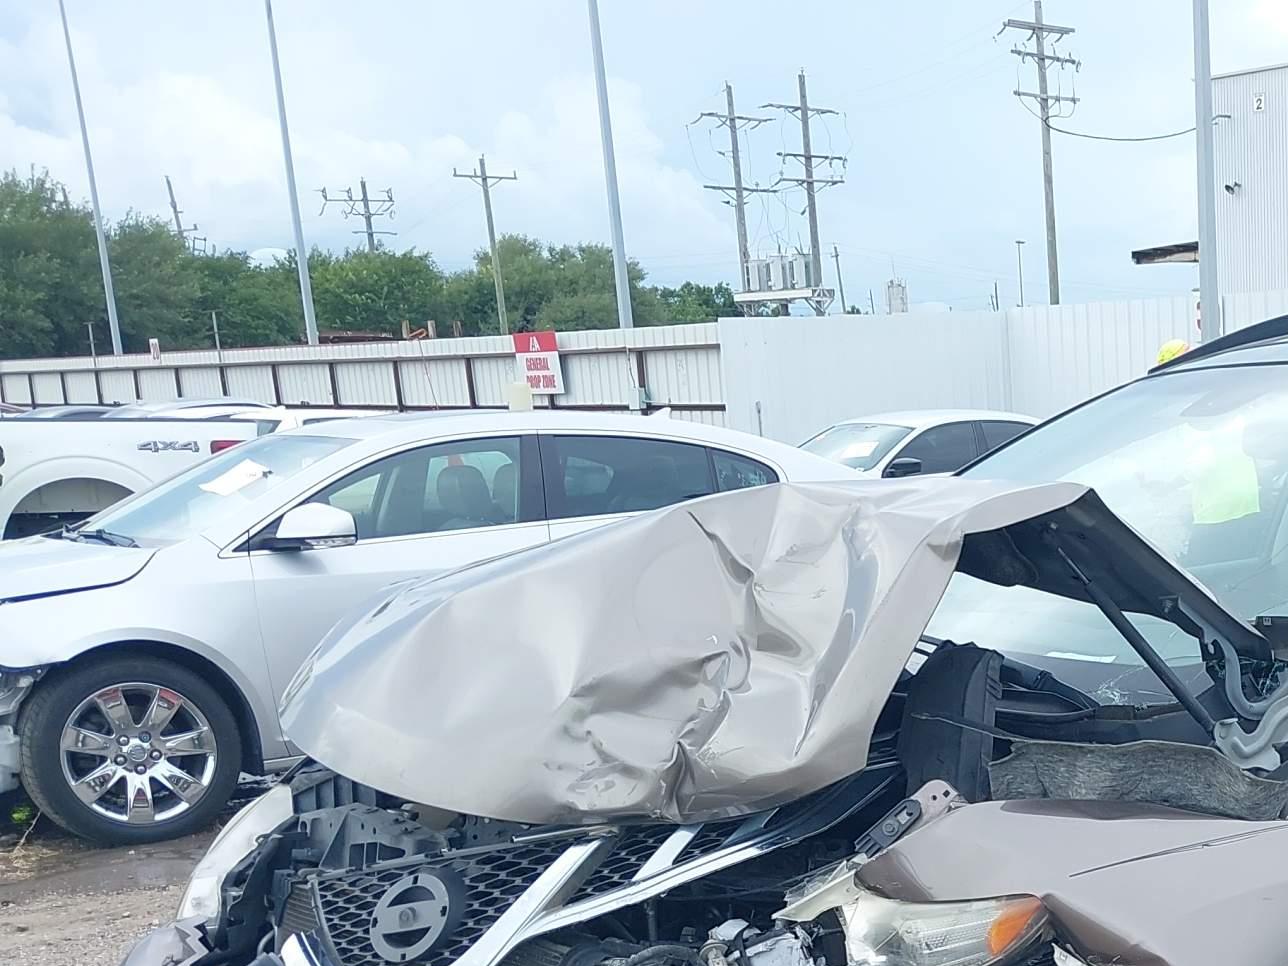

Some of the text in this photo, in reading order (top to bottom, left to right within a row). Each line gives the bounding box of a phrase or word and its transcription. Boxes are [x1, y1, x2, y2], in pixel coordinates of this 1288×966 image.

[1255, 98, 1263, 110] 2
[526, 357, 550, 371] GENERAL
[542, 374, 557, 389] ZONE
